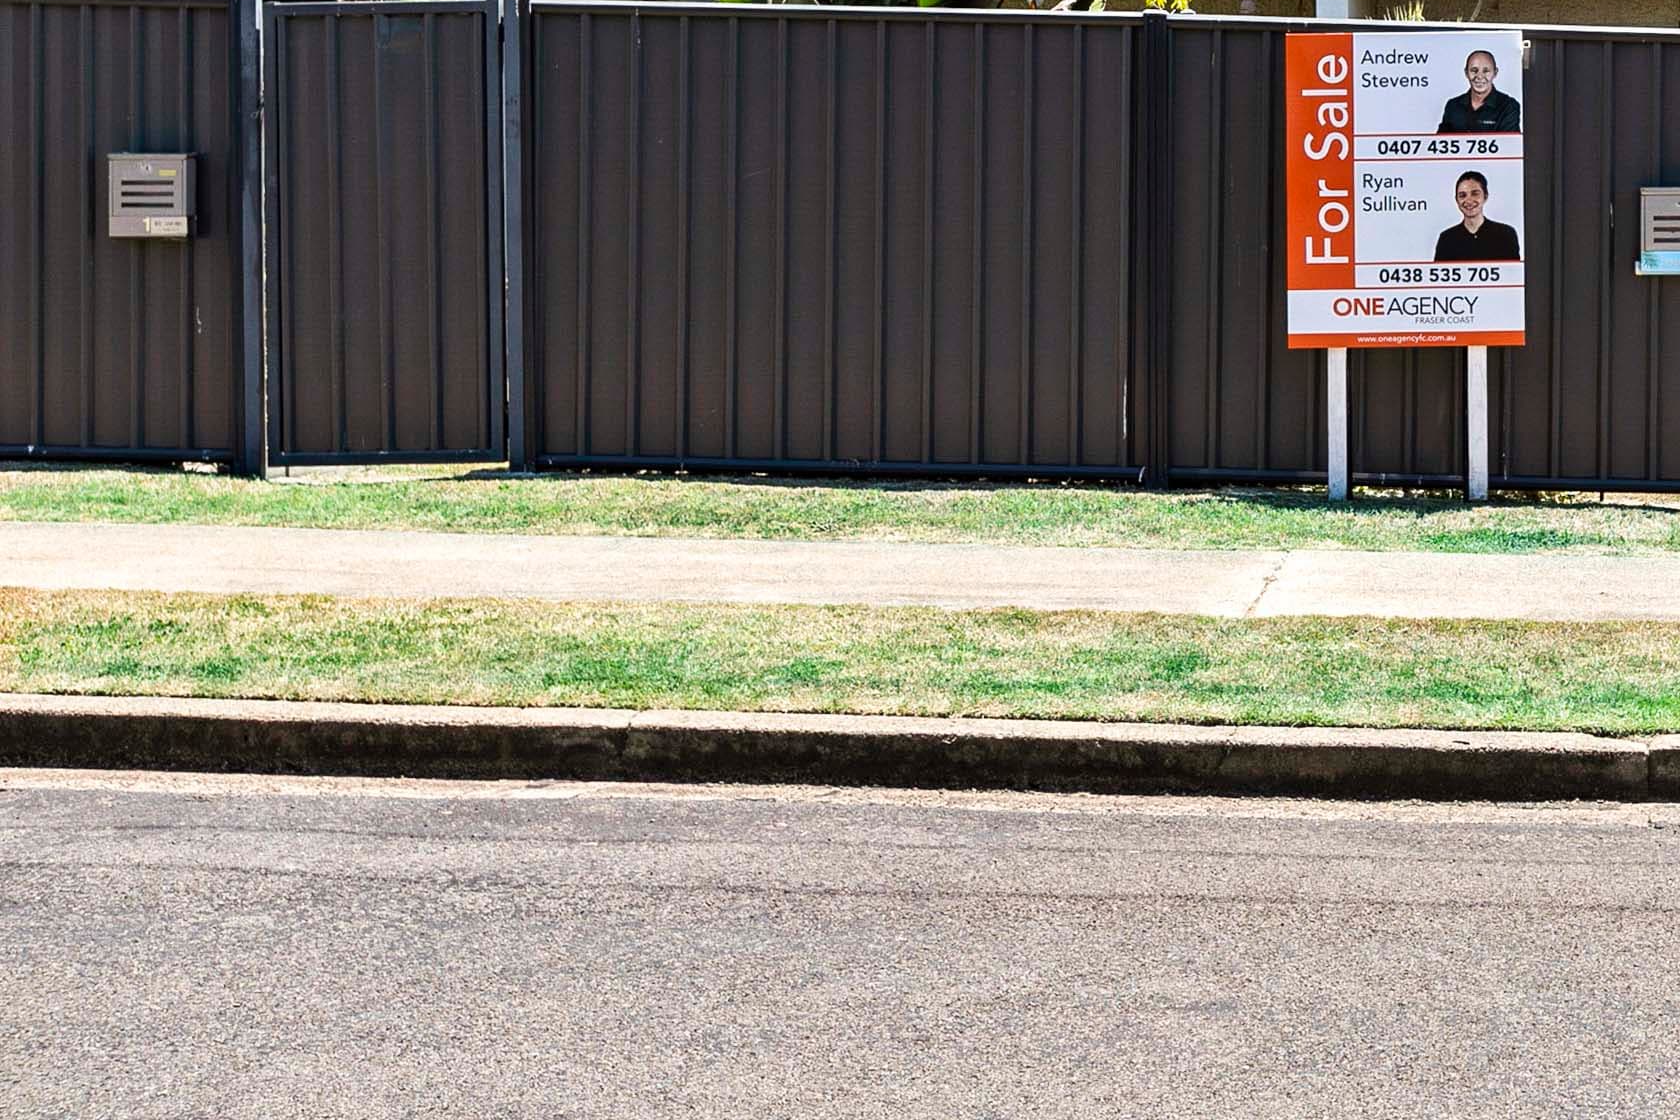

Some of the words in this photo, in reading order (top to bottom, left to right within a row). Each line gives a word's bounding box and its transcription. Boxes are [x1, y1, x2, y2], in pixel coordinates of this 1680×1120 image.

[1360, 48, 1429, 65] Andrew
[1361, 72, 1429, 88] Stevens
[1301, 54, 1350, 161] Sale
[1377, 140, 1422, 155] 0407
[1427, 140, 1460, 154] 435
[1466, 139, 1499, 154] 786
[1362, 173, 1404, 192] Ryan
[1362, 195, 1427, 212] Sullivan
[1304, 179, 1350, 265] For
[1379, 268, 1423, 283] 0438
[1429, 268, 1461, 283] 535
[1467, 267, 1500, 282] 705
[1415, 316, 1445, 325] FRASER
[1447, 316, 1475, 324] COAST
[1356, 334, 1457, 345] www.oneagencyfc.com.au
